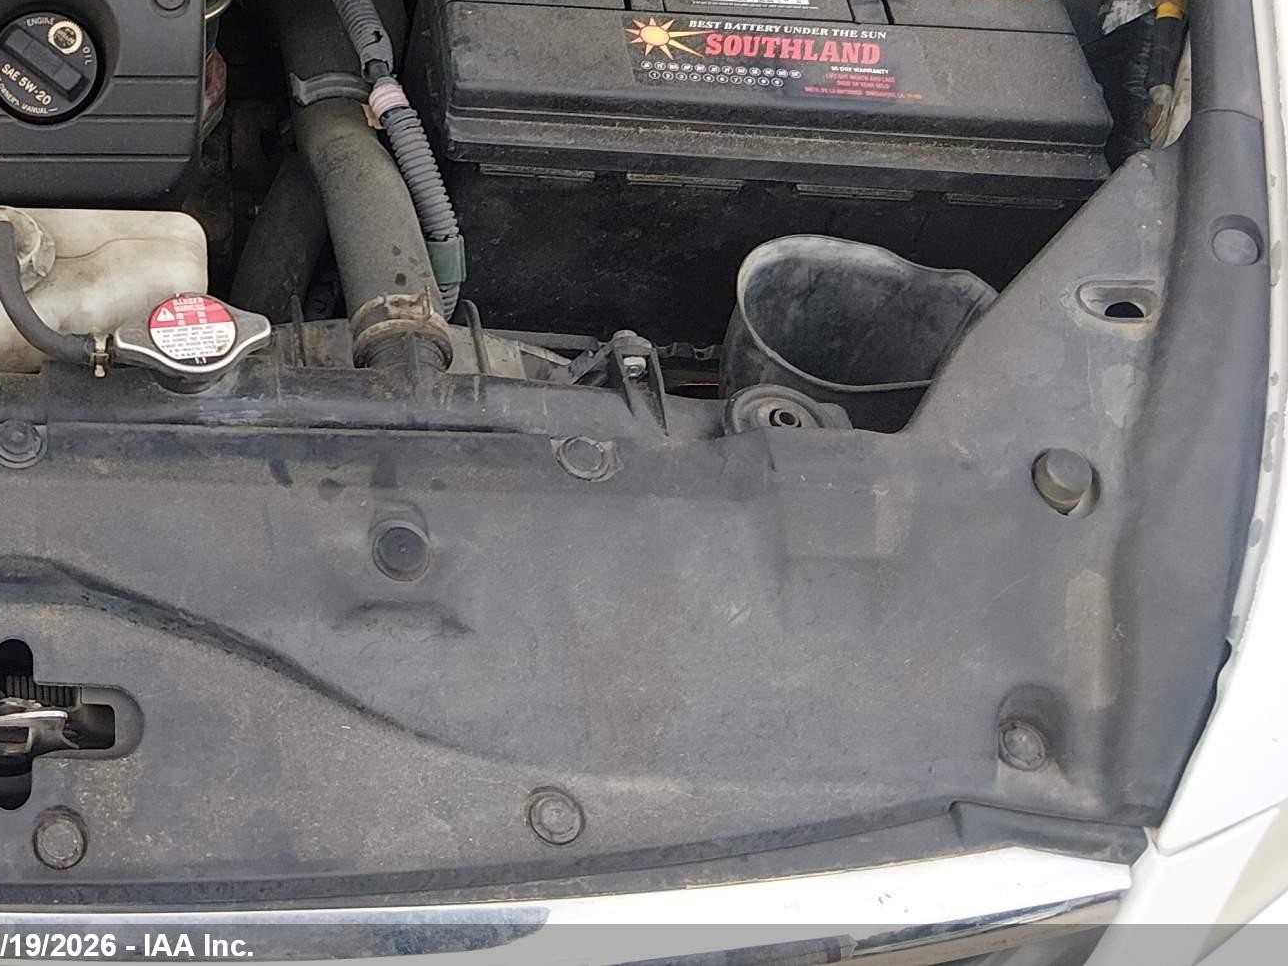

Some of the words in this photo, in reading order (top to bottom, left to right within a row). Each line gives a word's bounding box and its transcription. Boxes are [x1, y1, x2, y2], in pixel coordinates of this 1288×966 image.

[689, 20, 721, 30] BEST
[724, 22, 781, 34] BATTERY
[783, 26, 828, 37] UNDER
[831, 29, 858, 39] THE
[860, 31, 887, 40] SUN
[26, 17, 56, 27] ENGINE
[82, 46, 93, 65] OIL
[705, 32, 881, 66] SOUTHLAND
[1, 63, 20, 82] SAE
[21, 104, 49, 115] MANUAL
